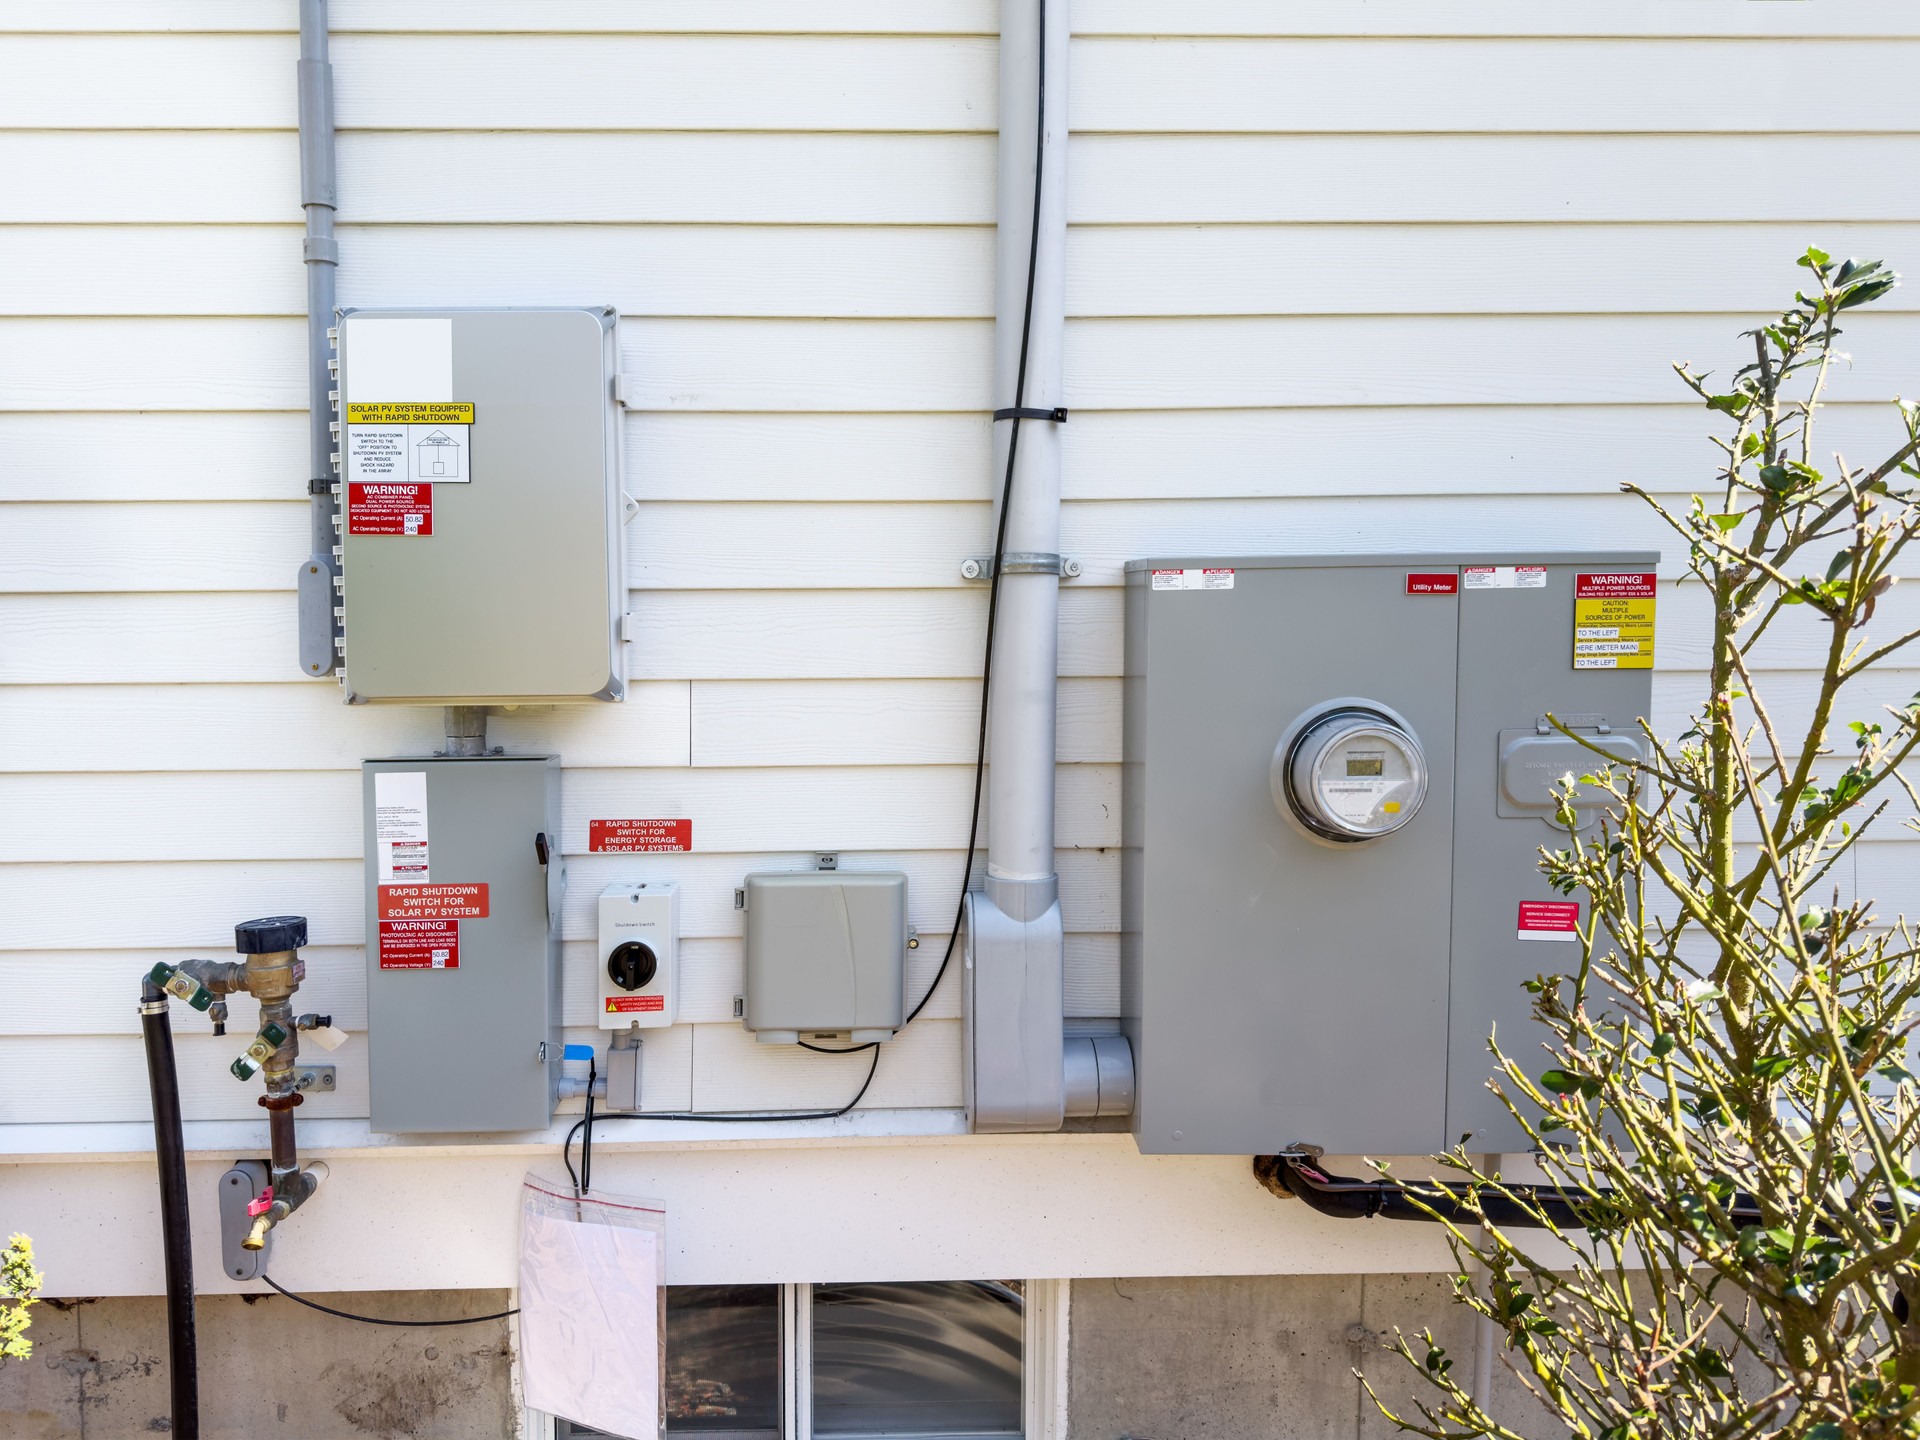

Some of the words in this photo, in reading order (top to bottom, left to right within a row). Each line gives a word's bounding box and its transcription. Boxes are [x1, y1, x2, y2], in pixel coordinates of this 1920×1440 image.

[363, 486, 418, 494] WARNING!
[1591, 576, 1642, 584] WARNING!
[1413, 583, 1431, 592] Utility
[1434, 583, 1451, 591] Meter
[390, 888, 418, 896] RAPID
[422, 887, 478, 895] SHUTDOWN
[404, 898, 440, 906] SWITCH
[392, 922, 446, 930] WARNING!
